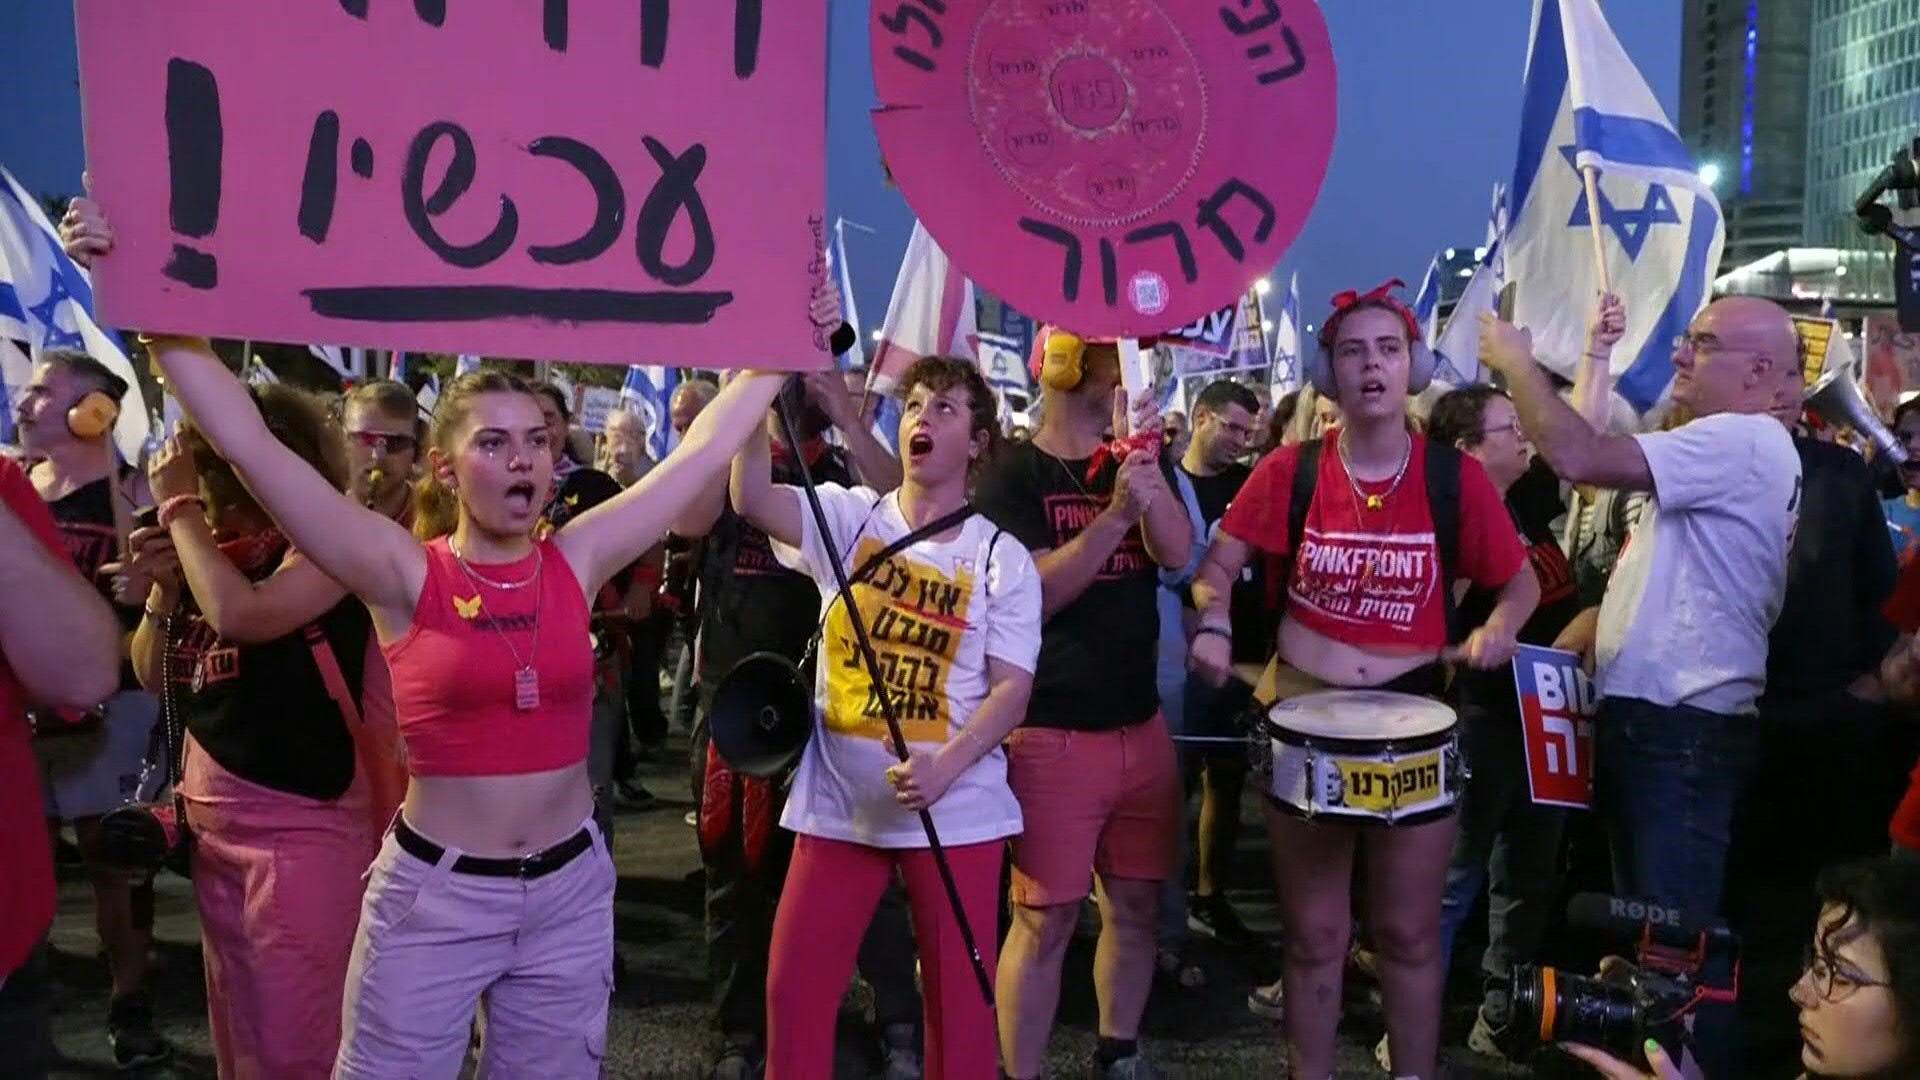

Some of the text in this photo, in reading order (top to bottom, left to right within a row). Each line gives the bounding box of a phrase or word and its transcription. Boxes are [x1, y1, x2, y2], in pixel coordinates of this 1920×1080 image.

[1018, 177, 1277, 307] מרור
[1303, 541, 1427, 579] PINKFRONT
[917, 579, 962, 616] אין
[871, 606, 951, 653] מנדט
[1350, 763, 1439, 804] הופקרנו
